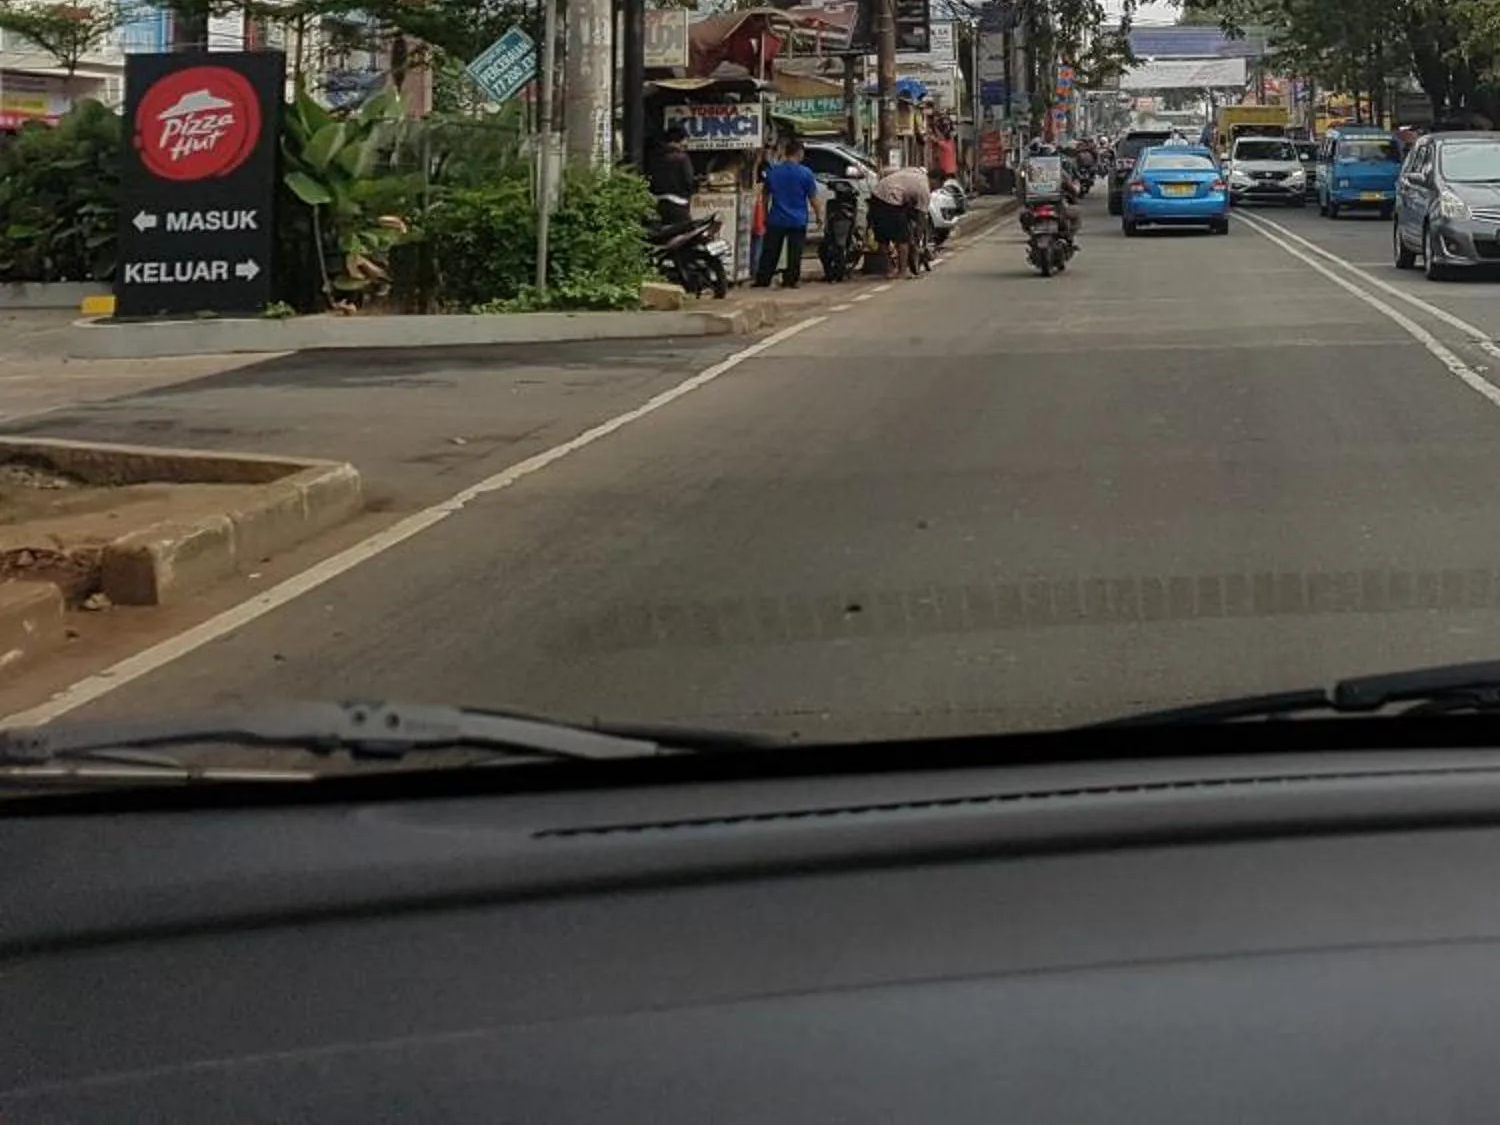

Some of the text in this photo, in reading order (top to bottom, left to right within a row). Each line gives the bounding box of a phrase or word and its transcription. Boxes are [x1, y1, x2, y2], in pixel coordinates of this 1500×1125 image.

[159, 113, 236, 150] Pizza
[668, 114, 760, 138] KUNCI
[169, 131, 225, 162] Hut
[166, 210, 258, 232] MASUK
[124, 260, 229, 284] KELUAR
